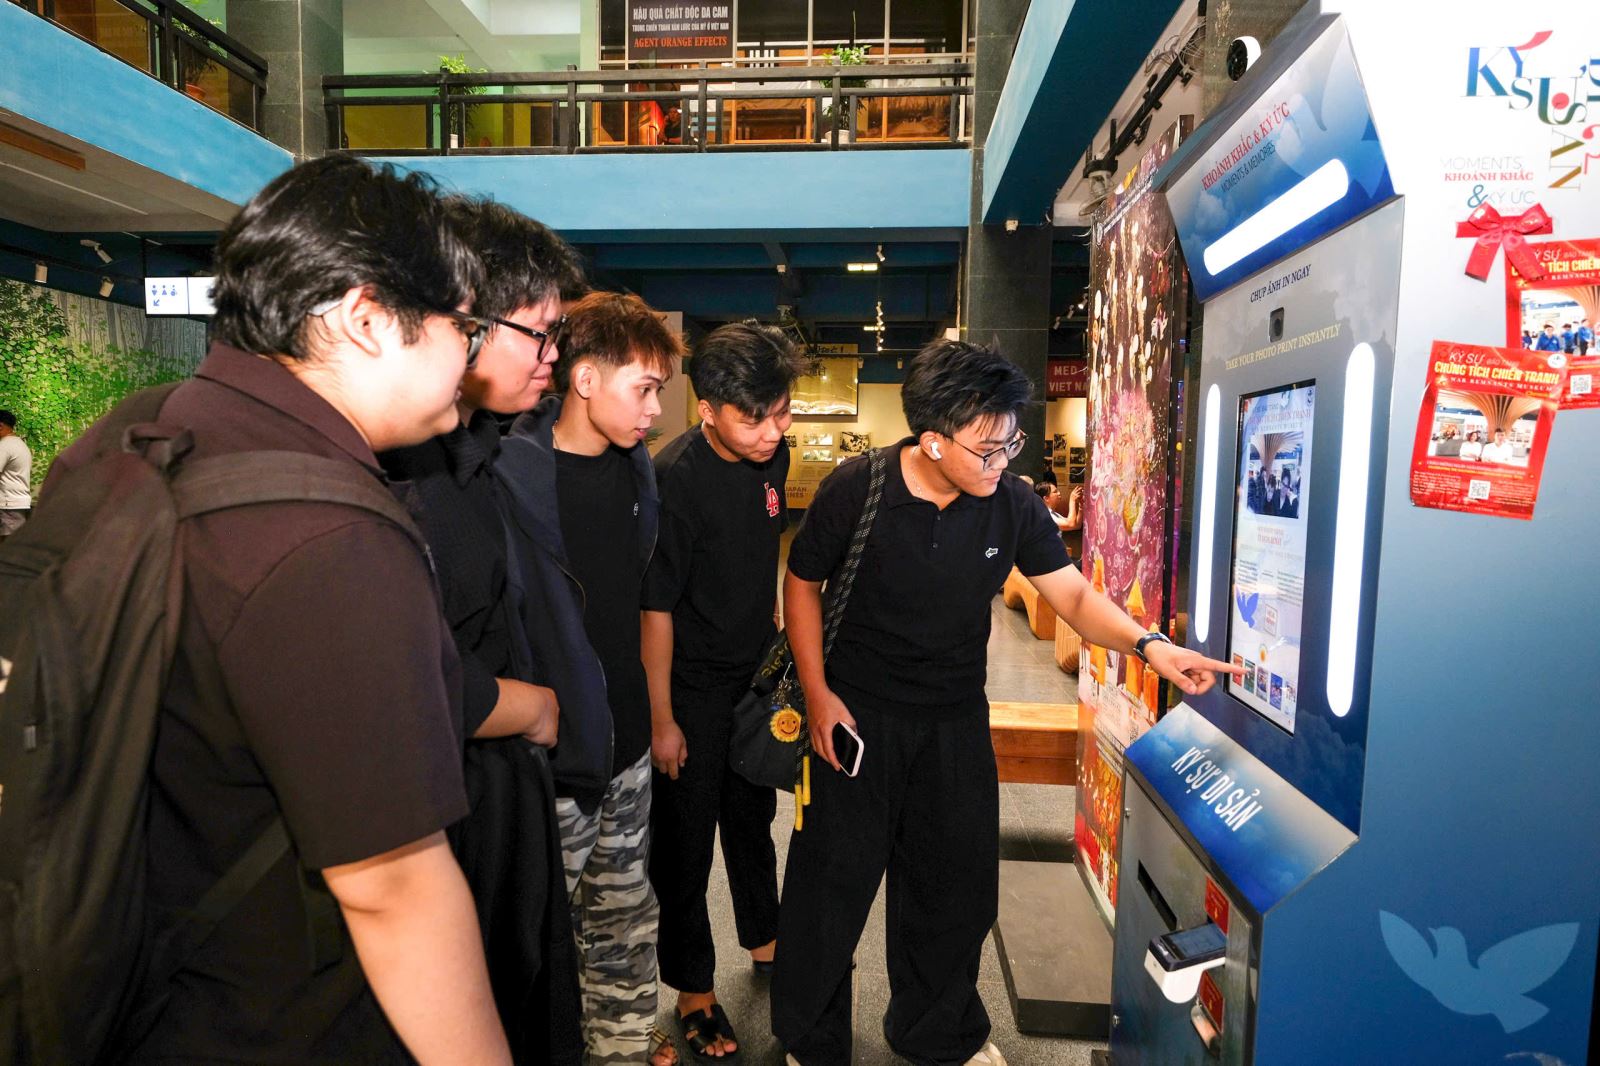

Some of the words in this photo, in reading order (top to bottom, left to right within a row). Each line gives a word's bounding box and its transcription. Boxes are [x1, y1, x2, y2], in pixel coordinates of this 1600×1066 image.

[712, 6, 728, 18] CAM
[634, 38, 659, 48] AGENT
[661, 37, 692, 47] ORANGE
[694, 36, 727, 46] EFFECTS
[1248, 140, 1277, 171] MEMORIES
[1440, 156, 1522, 170] MOMENTS
[1467, 184, 1489, 208] &
[1282, 275, 1290, 288] IN
[1290, 264, 1311, 284] NGAY
[1239, 353, 1255, 367] YOUR
[1255, 345, 1276, 361] PHOTO
[1277, 338, 1297, 355] PRINT
[1298, 323, 1341, 348] INSTANTLY
[1054, 365, 1077, 376] MED
[1524, 371, 1560, 384] TRANH
[1049, 382, 1072, 392] VIET
[764, 481, 779, 517] LA
[1171, 746, 1211, 775] KÝ
[1185, 760, 1222, 794] SỰ
[1200, 774, 1235, 805] DI
[1214, 788, 1263, 832] SẢN
